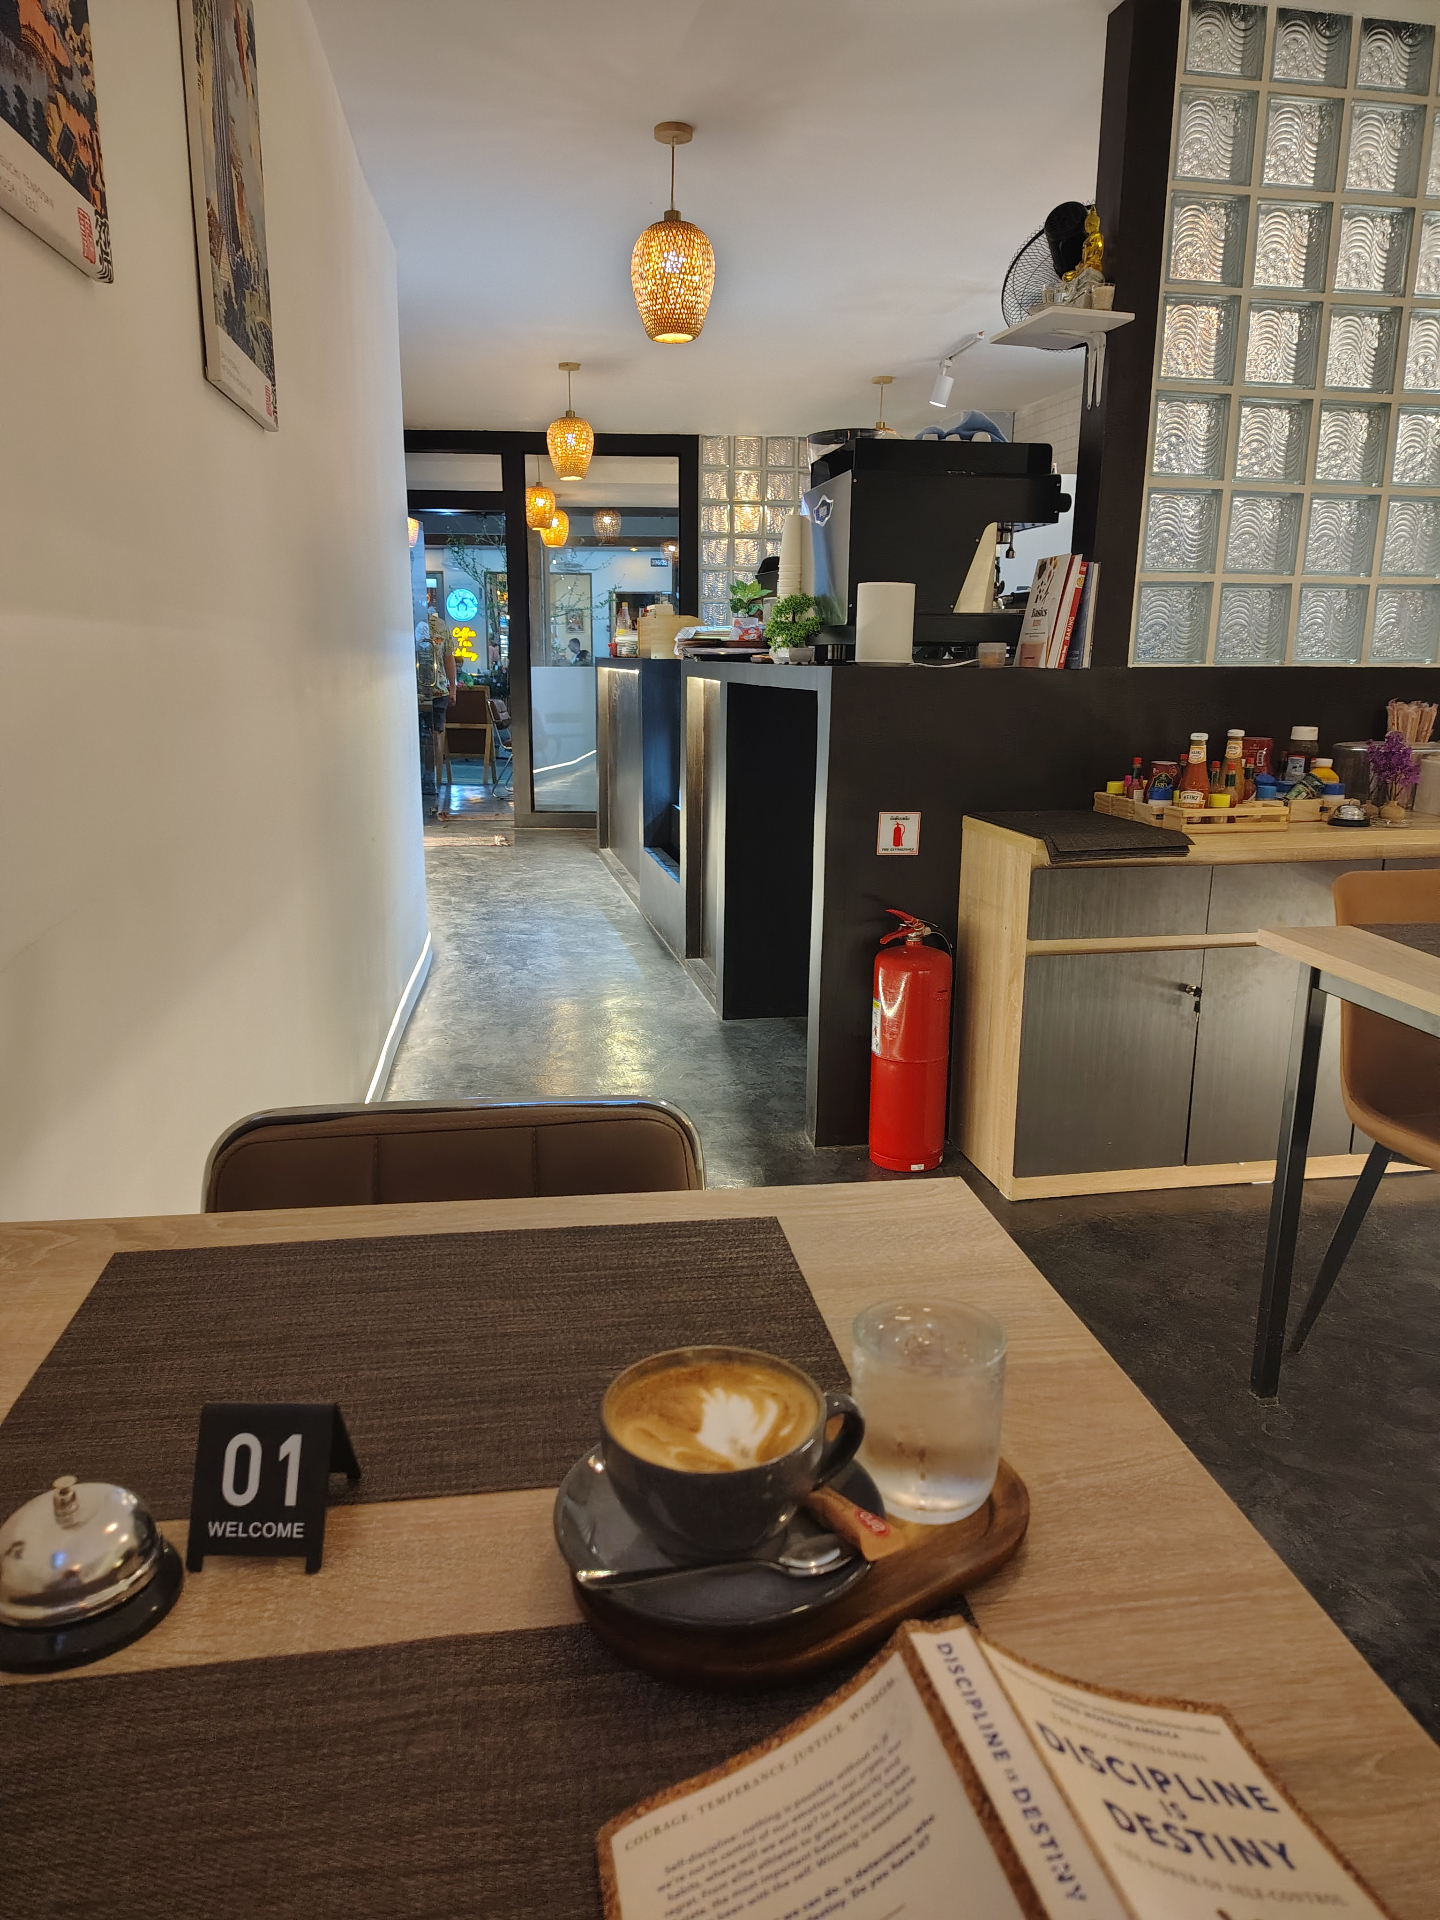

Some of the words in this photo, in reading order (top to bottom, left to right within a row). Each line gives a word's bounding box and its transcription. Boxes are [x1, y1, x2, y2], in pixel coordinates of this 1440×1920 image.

[1031, 606, 1048, 618] Basics
[222, 1432, 302, 1507] 01
[208, 1521, 305, 1539] WELCOME
[937, 1641, 1010, 1762] DISCIPLINE
[1012, 1787, 1087, 1901] DESTINY
[1036, 1719, 1280, 1814] DISCIPLINE
[1103, 1799, 1296, 1871] DESTINY
[1158, 1799, 1188, 1821] IS
[802, 1896, 822, 1911] can
[855, 1835, 913, 1880] determines
[914, 1815, 935, 1835] who
[870, 1870, 889, 1889] you
[890, 1849, 916, 1871] have
